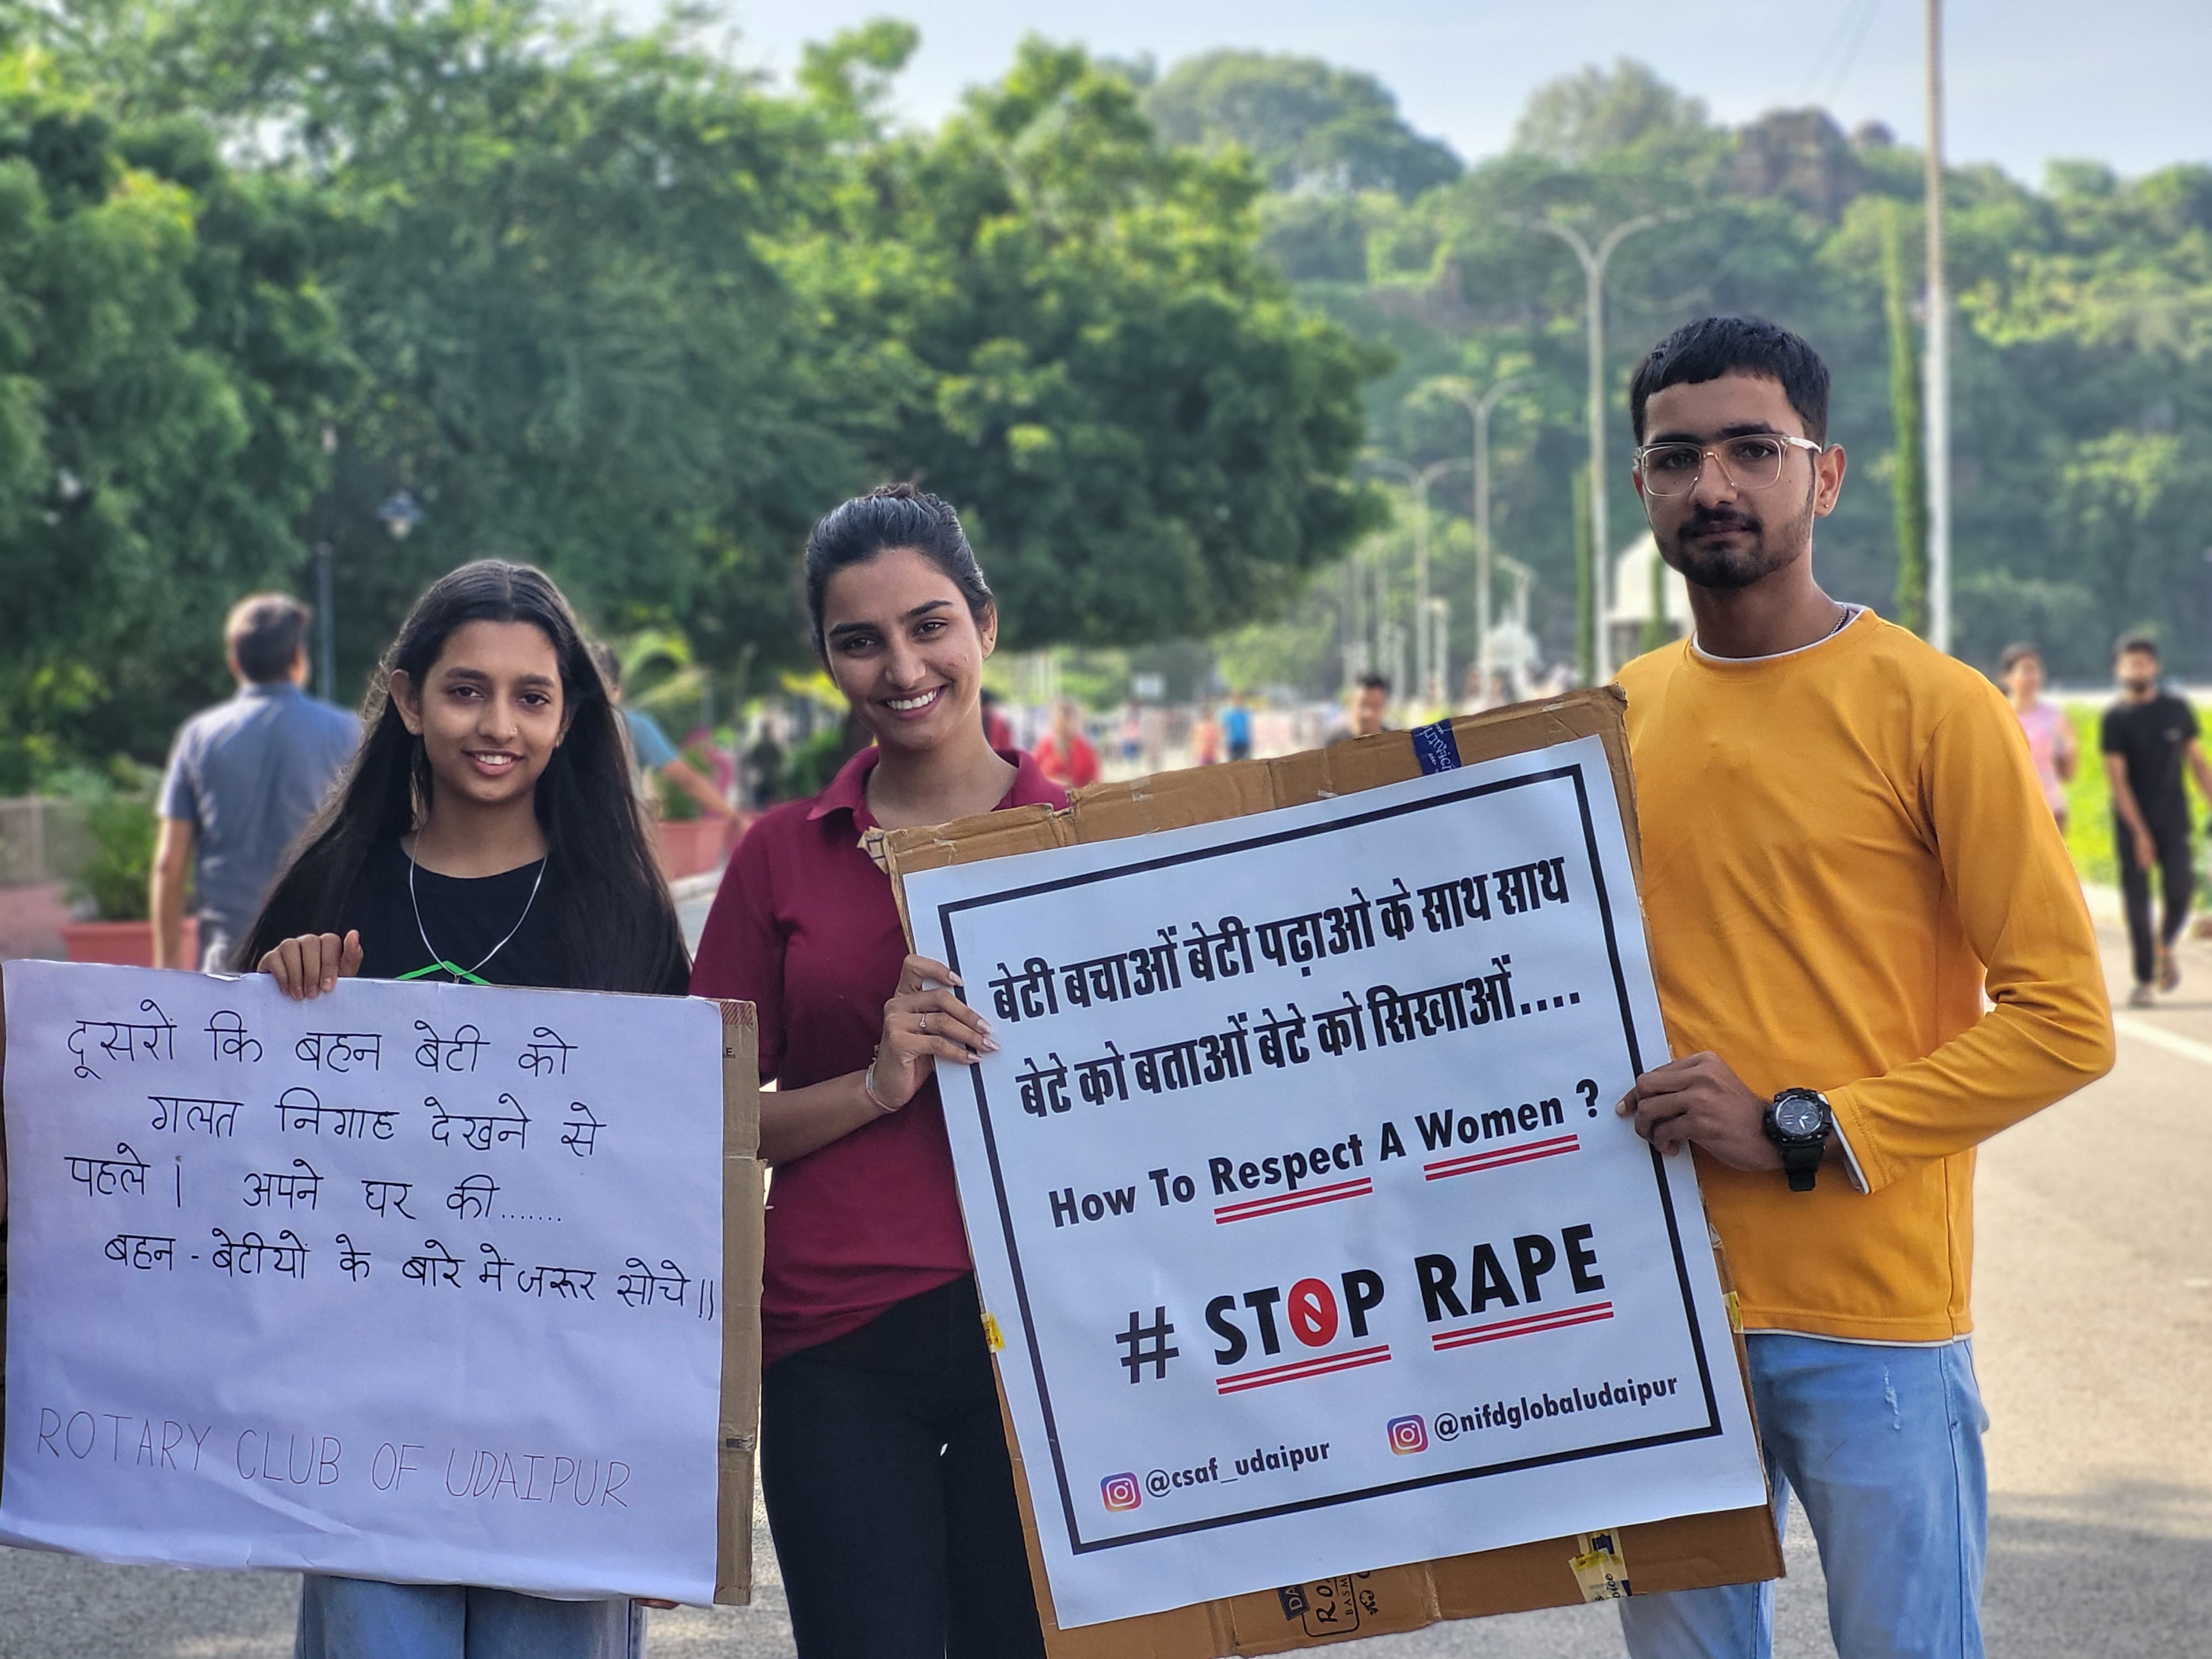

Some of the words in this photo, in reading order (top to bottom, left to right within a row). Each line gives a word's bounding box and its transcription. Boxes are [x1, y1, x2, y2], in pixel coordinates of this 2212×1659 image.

[988, 957, 1058, 1022] बेटी
[1060, 926, 1181, 1008] बचाओं
[1183, 916, 1254, 982] बेटी
[1376, 878, 1414, 940] के
[1417, 874, 1491, 932] साथ
[1492, 857, 1569, 915] साथ
[204, 1010, 262, 1062] कि
[295, 1032, 382, 1072] बहन
[414, 1020, 491, 1073] बेटी
[519, 1027, 578, 1077] को
[1015, 1052, 1071, 1117] बेटे
[1074, 1041, 1129, 1105] को
[1130, 1012, 1252, 1094] बताओं
[1253, 1003, 1310, 1068] बेटे
[1312, 991, 1366, 1056] को
[148, 1096, 244, 1138] गलत
[274, 1087, 400, 1139] निगाह
[424, 1093, 532, 1150] देखने
[561, 1102, 607, 1157] से
[64, 1142, 151, 1197] पहले
[243, 1159, 324, 1210] अपने
[361, 1180, 416, 1219] घर
[1048, 1186, 1135, 1228] How
[1149, 1168, 1195, 1206] To
[1209, 1134, 1363, 1195] Respect
[1380, 1122, 1406, 1161] A
[1415, 1098, 1564, 1153] Women
[105, 1234, 176, 1271] बहन
[336, 1234, 371, 1282] के
[402, 1239, 466, 1288] बारे
[1115, 1306, 1179, 1384] #
[1205, 1269, 1385, 1365] STOP
[1413, 1223, 1605, 1323] RAPE
[1434, 1378, 1677, 1441] @nifdglobaludaipur
[37, 1407, 212, 1471] ROTARY
[236, 1430, 342, 1485] CLUB
[372, 1443, 425, 1490] OF
[446, 1448, 630, 1507] UDAIPUR
[1146, 1443, 1329, 1498] @csaf_udaipur
